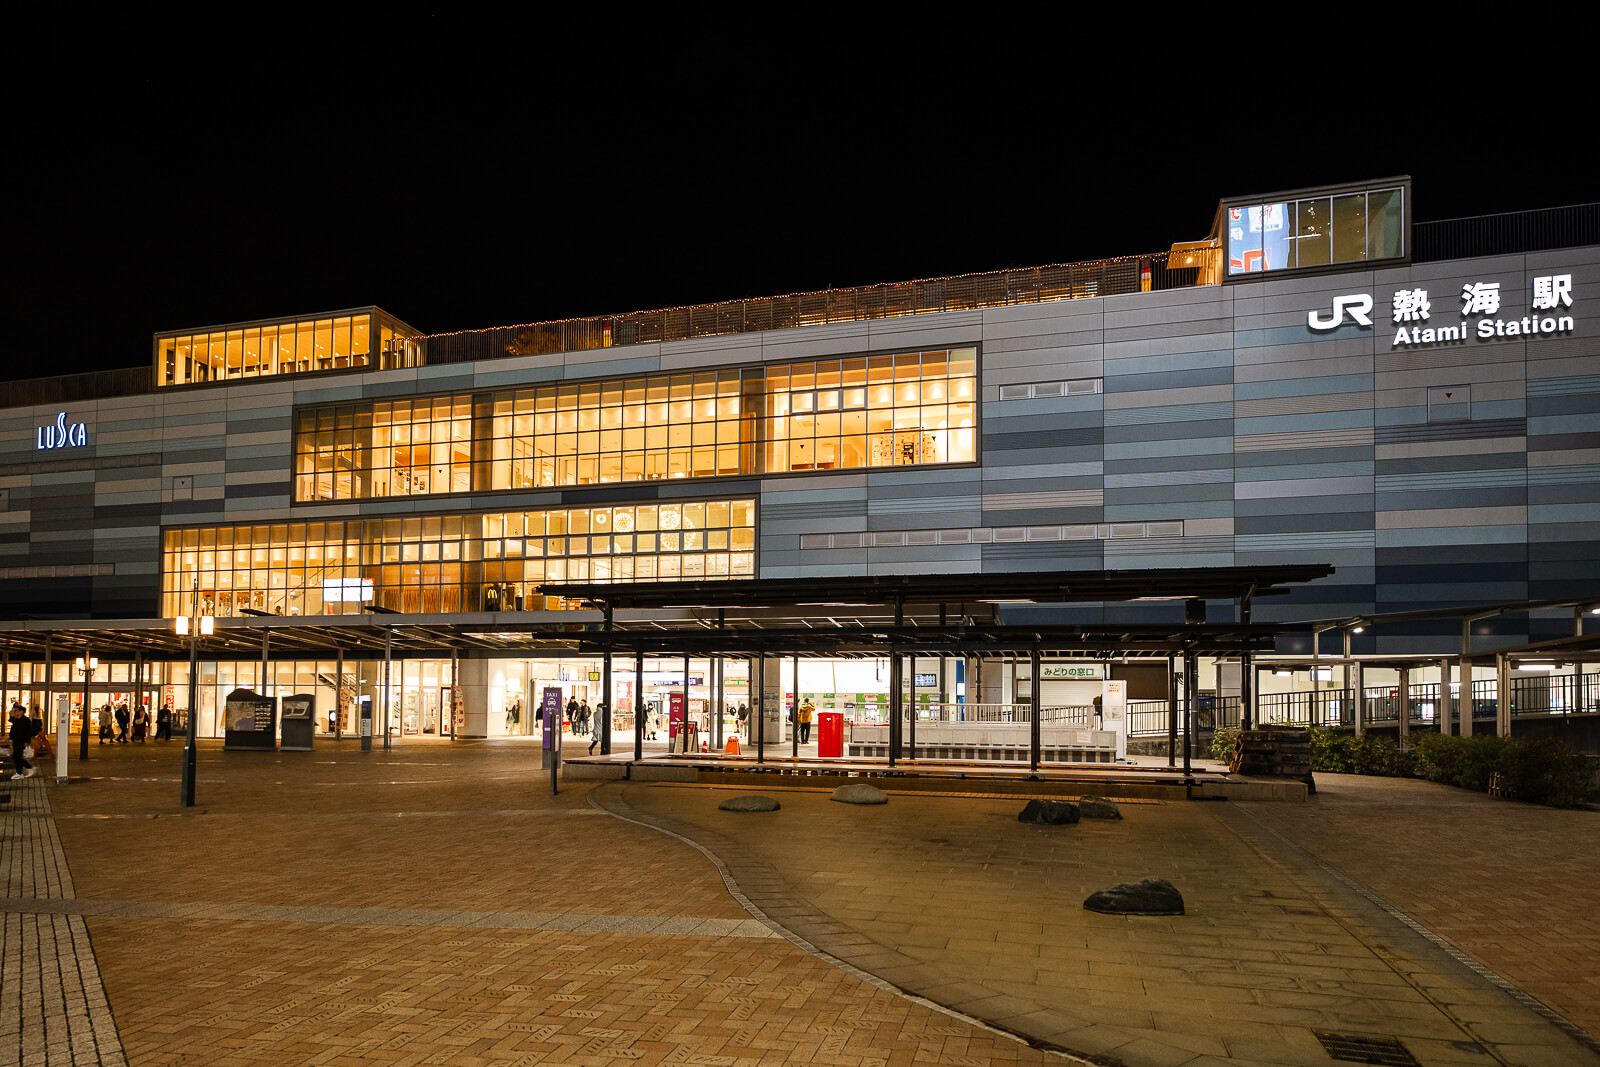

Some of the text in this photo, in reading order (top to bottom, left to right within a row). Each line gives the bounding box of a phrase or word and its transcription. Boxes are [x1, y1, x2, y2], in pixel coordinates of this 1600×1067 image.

[1308, 293, 1374, 330] JR
[1392, 274, 1573, 323] 熱海駅
[1393, 314, 1574, 346] Atami Station
[37, 411, 86, 449] LUSCA
[1044, 667, 1094, 676] みどりの窓口
